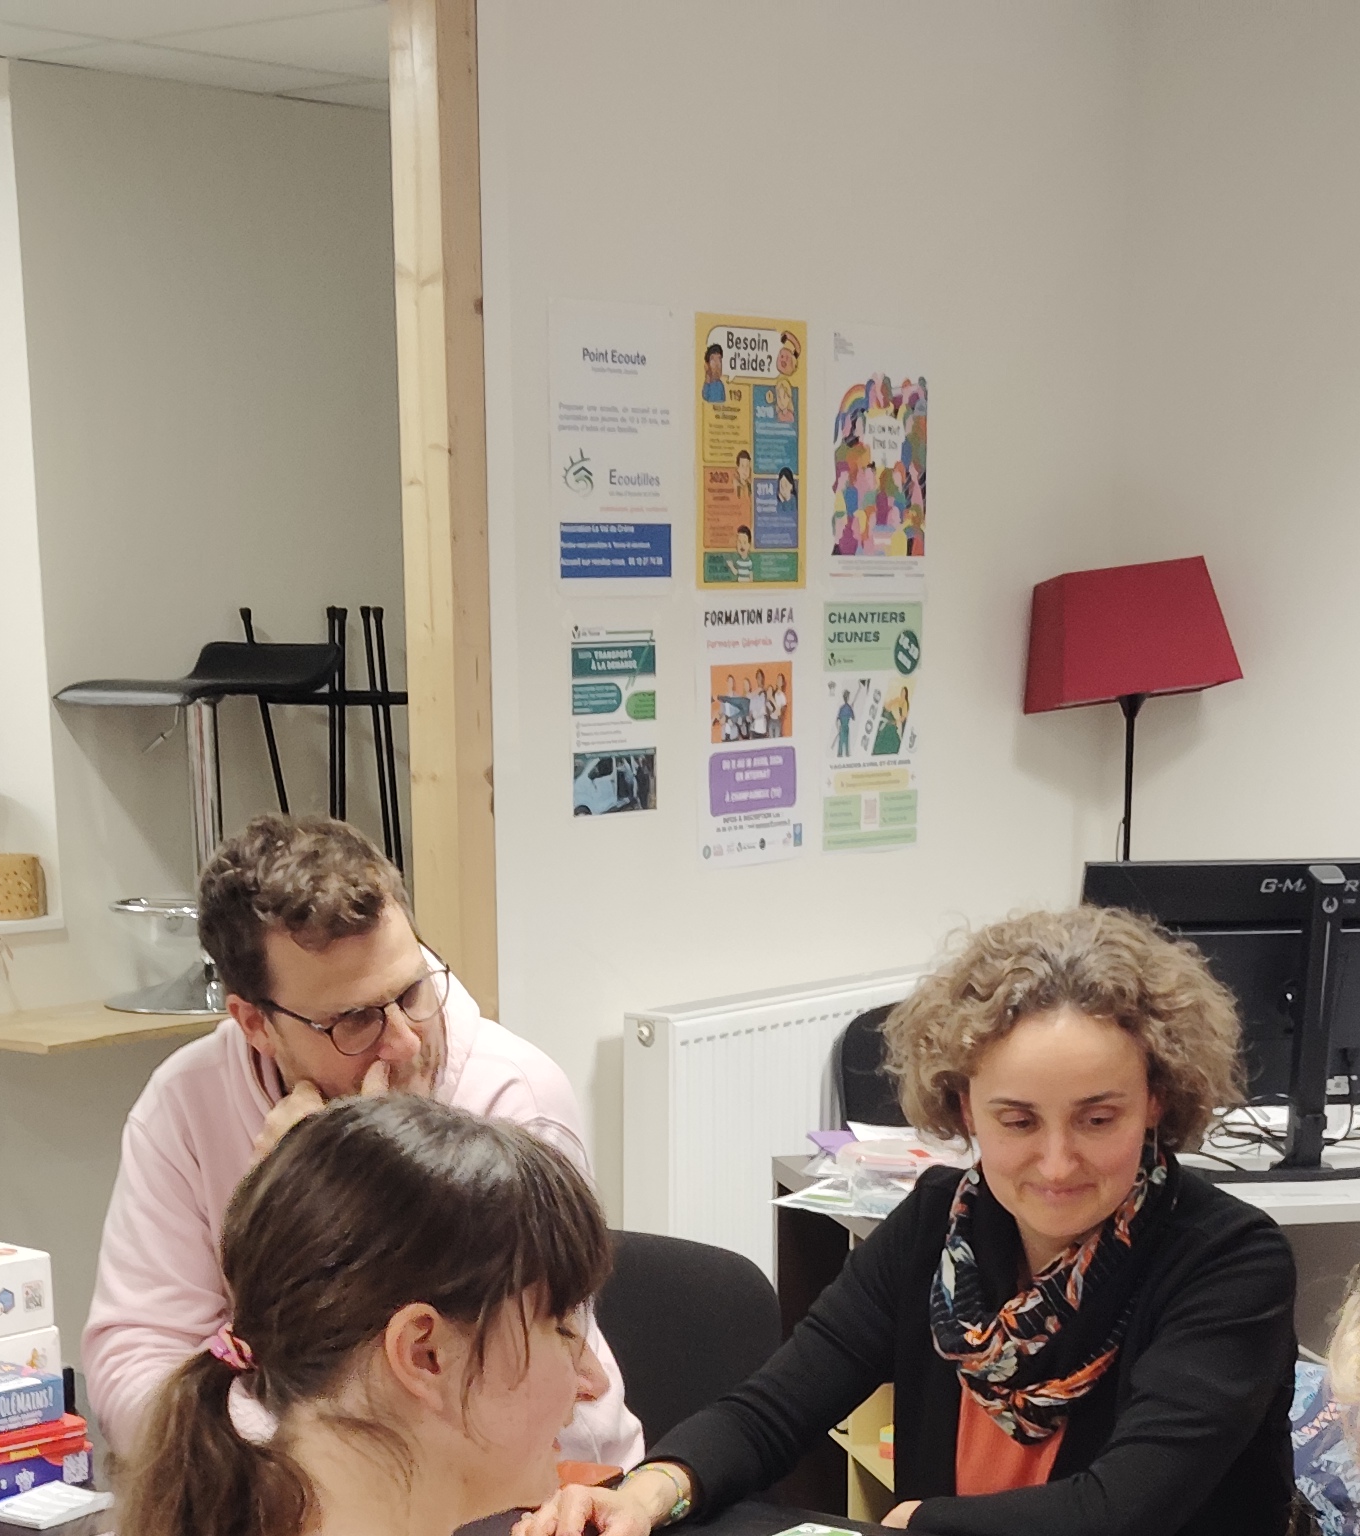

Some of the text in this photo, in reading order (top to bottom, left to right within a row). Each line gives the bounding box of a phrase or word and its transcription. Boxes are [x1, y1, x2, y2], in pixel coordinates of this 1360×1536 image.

[726, 331, 769, 352] Besoin
[582, 347, 647, 366] Point Ecoute
[729, 352, 773, 373] d'aide?
[609, 468, 661, 487] Ecoutilles
[703, 606, 795, 628] FORMATION BAFA
[828, 611, 906, 624] CHANTIERS
[828, 630, 880, 643] JEUNES
